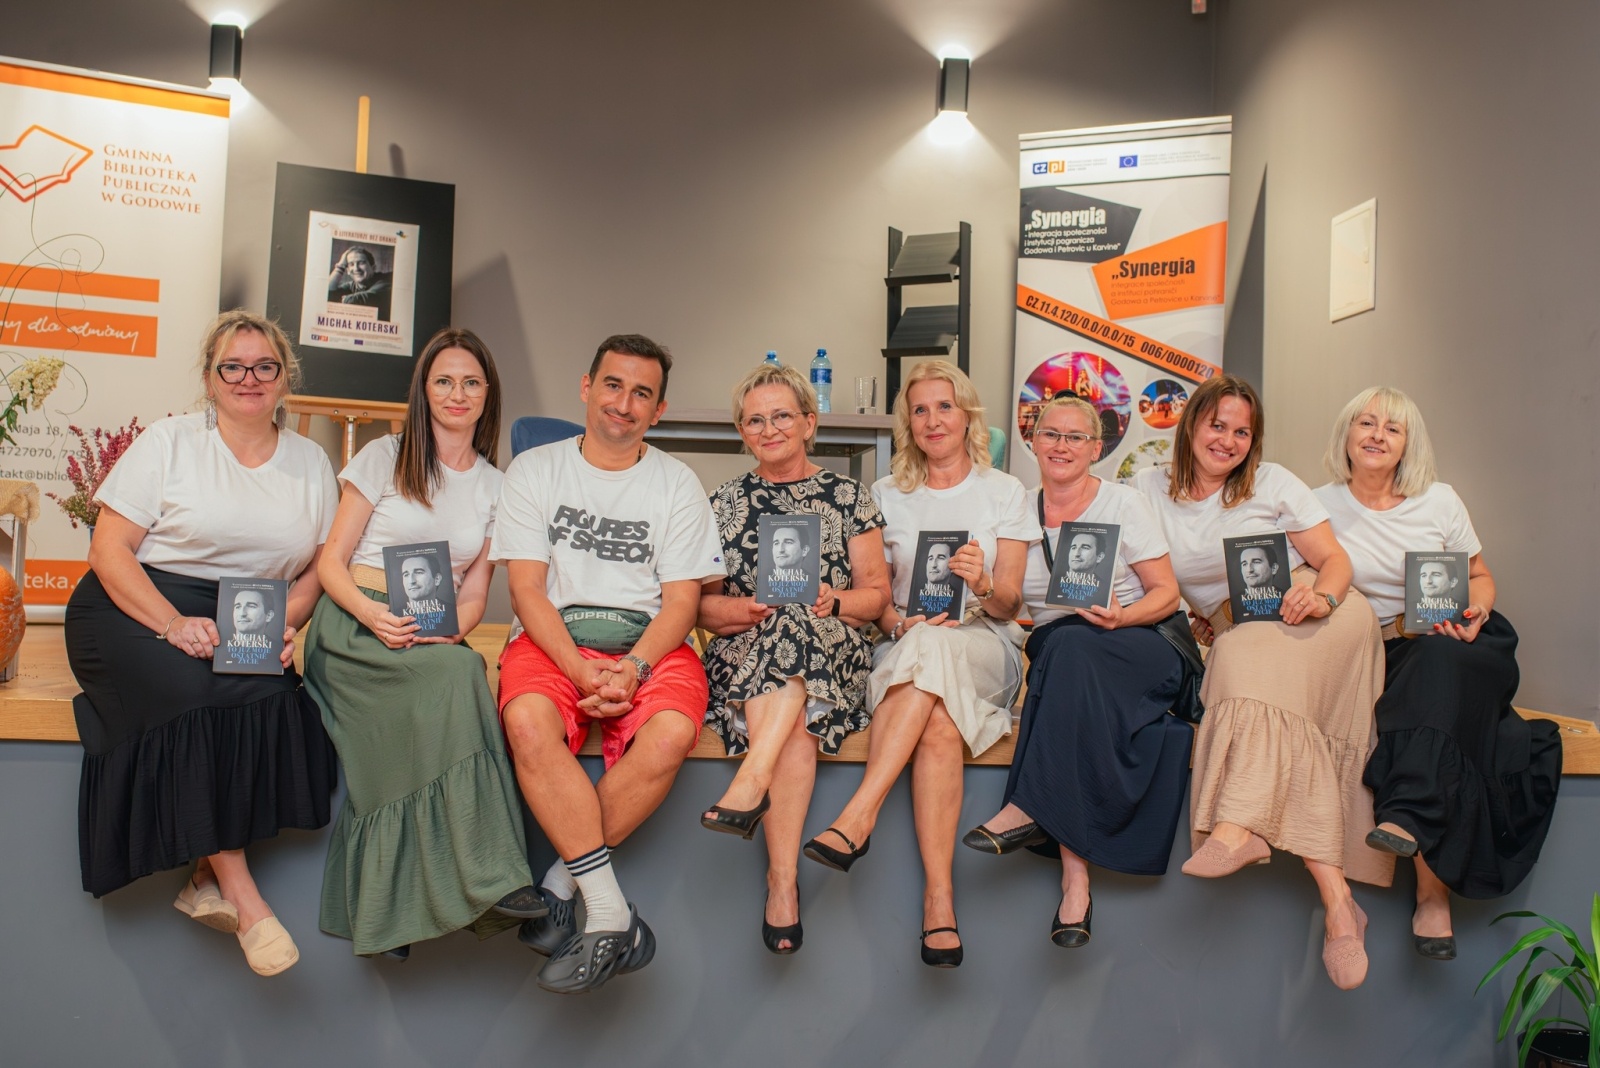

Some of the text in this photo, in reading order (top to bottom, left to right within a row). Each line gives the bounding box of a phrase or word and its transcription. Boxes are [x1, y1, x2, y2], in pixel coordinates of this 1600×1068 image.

[103, 144, 172, 164] GMINNA
[103, 159, 197, 183] BIBLIOTEKA
[103, 175, 192, 197] PUBLICZNA
[121, 193, 201, 214] GODOWIE
[1028, 230, 1062, 239] integracja
[1056, 236, 1095, 246] pogranicza
[1024, 246, 1053, 255] Godowa
[317, 316, 398, 335] MICHAŁ KOTERSKI
[27, 315, 61, 334] dla
[66, 321, 140, 353] odmiany
[0, 469, 69, 481] takt@biblio
[553, 504, 650, 541] FIGURES
[24, 571, 80, 589] teka.
[1060, 576, 1100, 587] KOTERSKI
[1241, 591, 1282, 601] KOTERSKI
[402, 604, 446, 616] KOTERSKI
[227, 640, 272, 649] KOTERSKI
